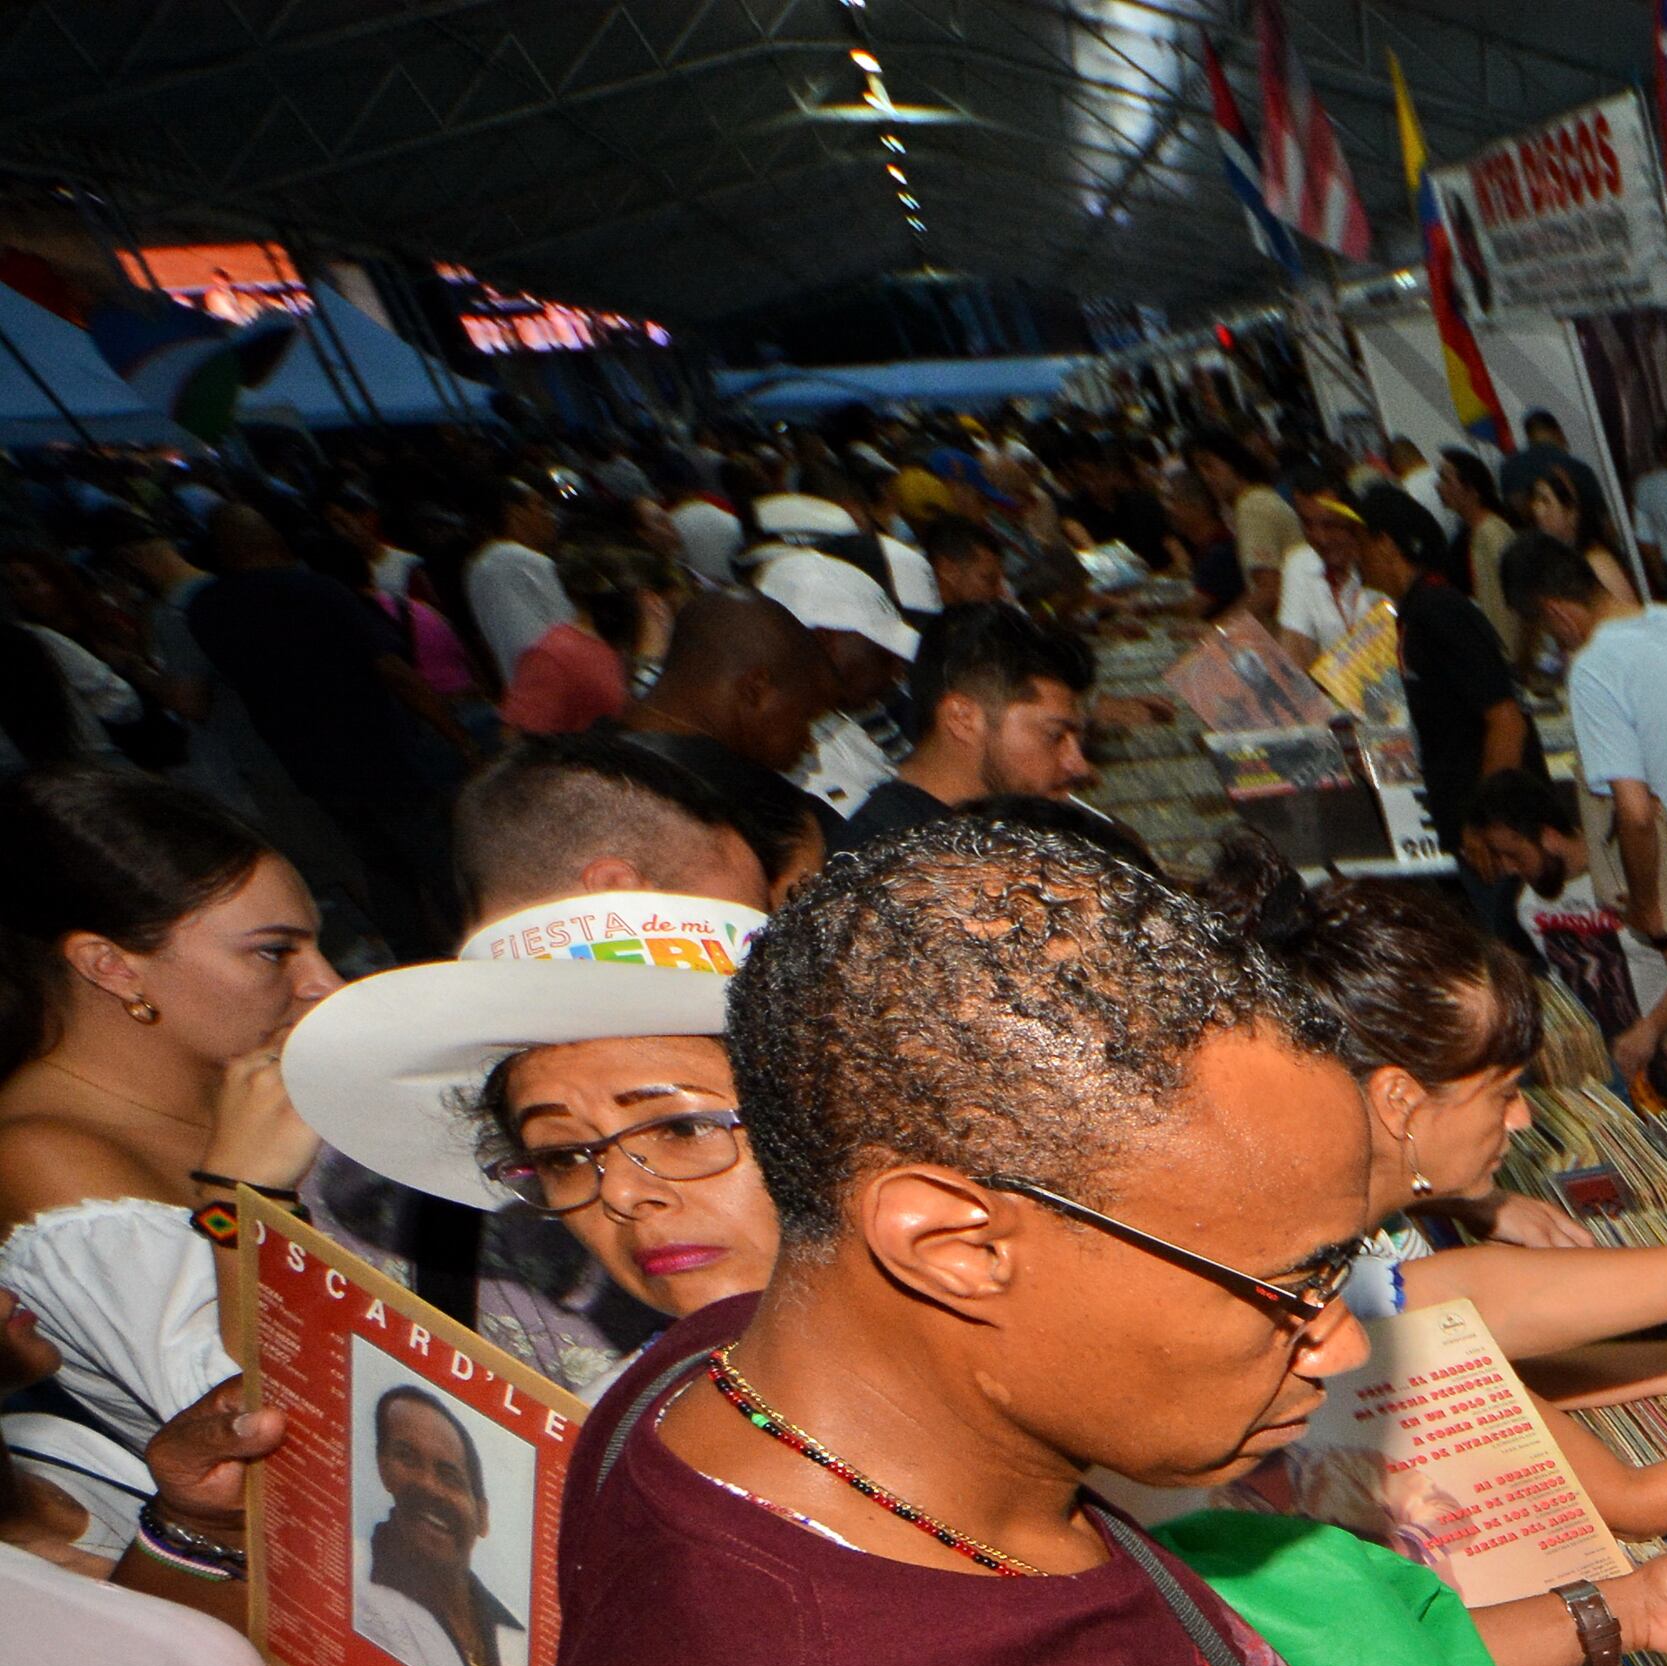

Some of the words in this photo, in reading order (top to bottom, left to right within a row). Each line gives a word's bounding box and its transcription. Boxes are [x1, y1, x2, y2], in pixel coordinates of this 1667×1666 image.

[490, 912, 637, 960] FIESTA
[642, 914, 677, 933] de
[681, 919, 715, 934] mi
[1429, 1355, 1493, 1381] SABROSO
[1400, 1414, 1421, 1430] EN
[1424, 1407, 1447, 1422] UN
[1451, 1396, 1486, 1414] SOLO
[1490, 1387, 1514, 1403] PIE
[1412, 1433, 1425, 1446] A
[1426, 1420, 1473, 1442] COMER
[1387, 1453, 1428, 1473] RAYO
[1432, 1448, 1450, 1461] DE
[1473, 1480, 1493, 1493] MI
[1495, 1459, 1556, 1486] BURRITO
[1484, 1517, 1501, 1531] DE
[1505, 1507, 1530, 1523] LOS
[1533, 1492, 1576, 1513] LOCOS
[1485, 1495, 1504, 1510] DE
[1463, 1532, 1518, 1556] SIRENA
[1522, 1522, 1545, 1538] DEL
[1548, 1508, 1586, 1527] AMOR
[1538, 1525, 1595, 1551] SOLEDAD
